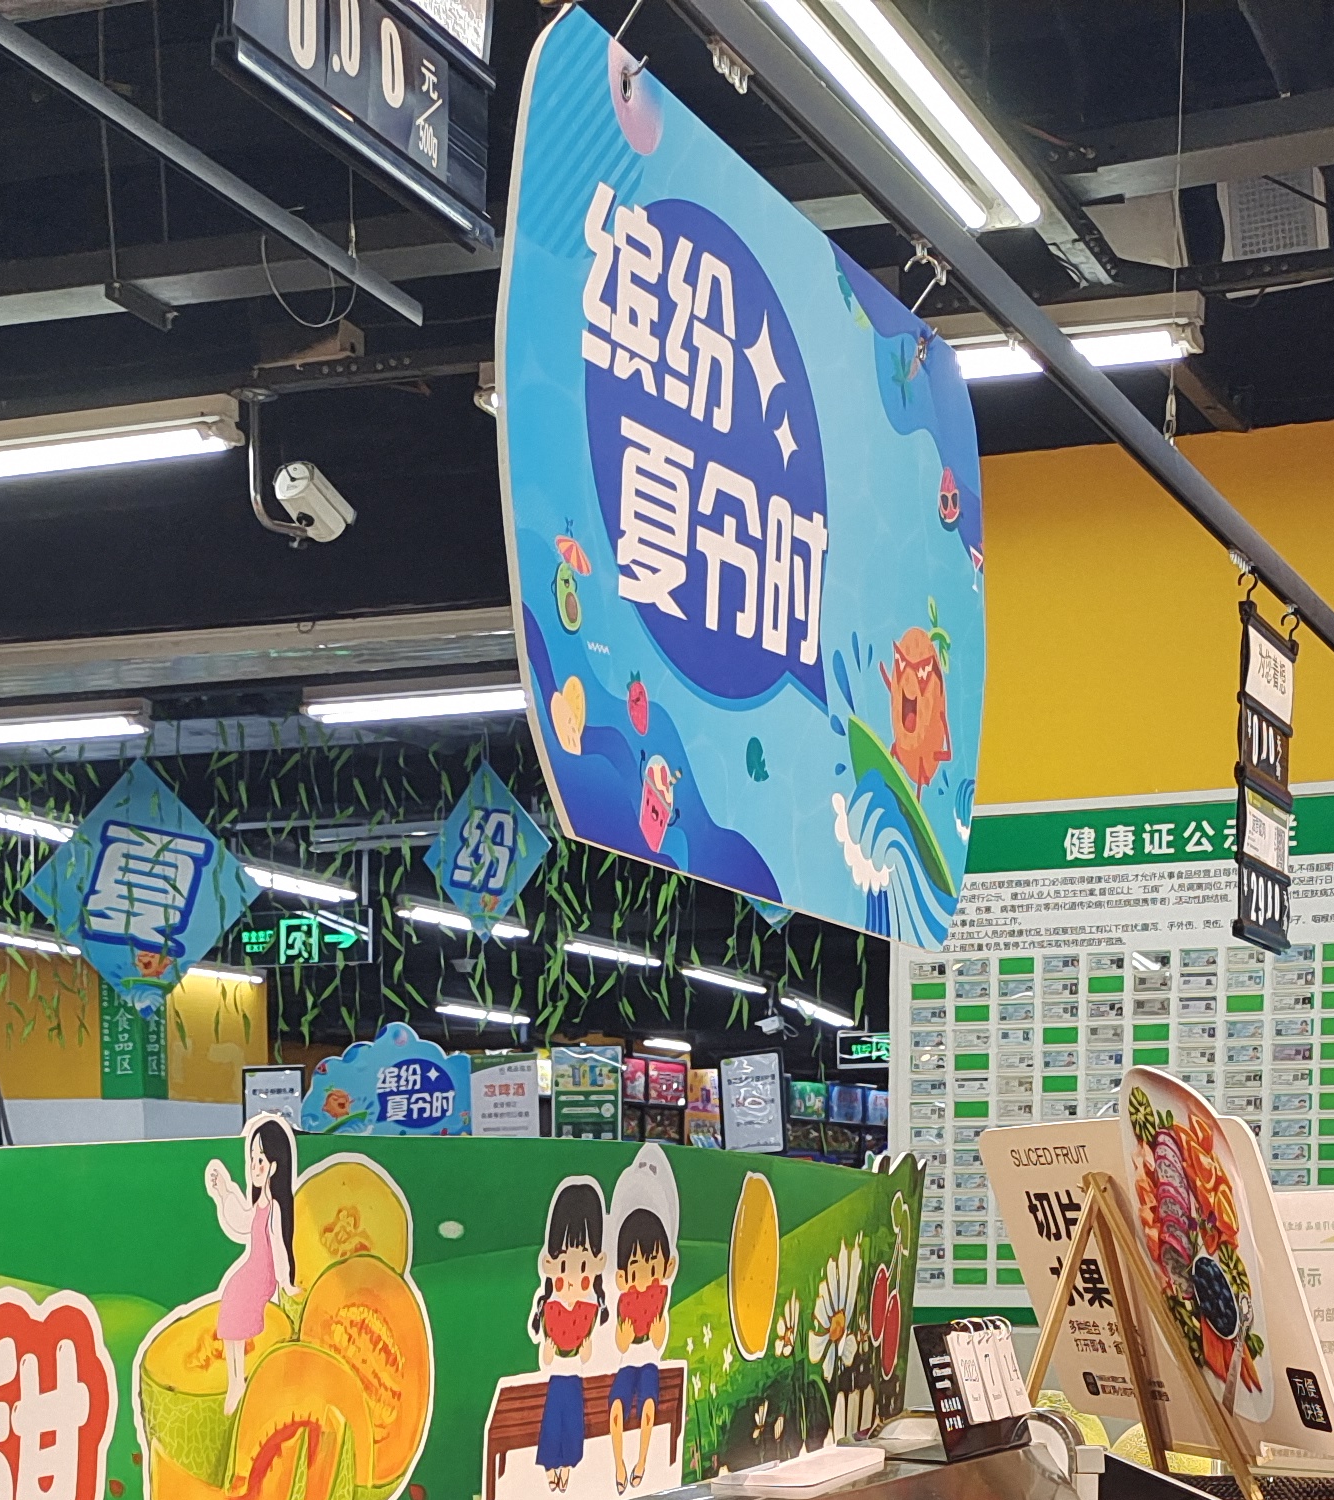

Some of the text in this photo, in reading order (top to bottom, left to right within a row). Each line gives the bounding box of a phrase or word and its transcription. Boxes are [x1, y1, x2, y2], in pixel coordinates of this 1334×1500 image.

[580, 181, 737, 435] 缤纷
[617, 416, 829, 668] 夏分时
[85, 822, 209, 948] 夏
[451, 806, 517, 893] 纷
[376, 1063, 421, 1093] 缤纷
[1010, 1145, 1090, 1168] SLICED FRUIT
[1025, 1189, 1082, 1242] 切片
